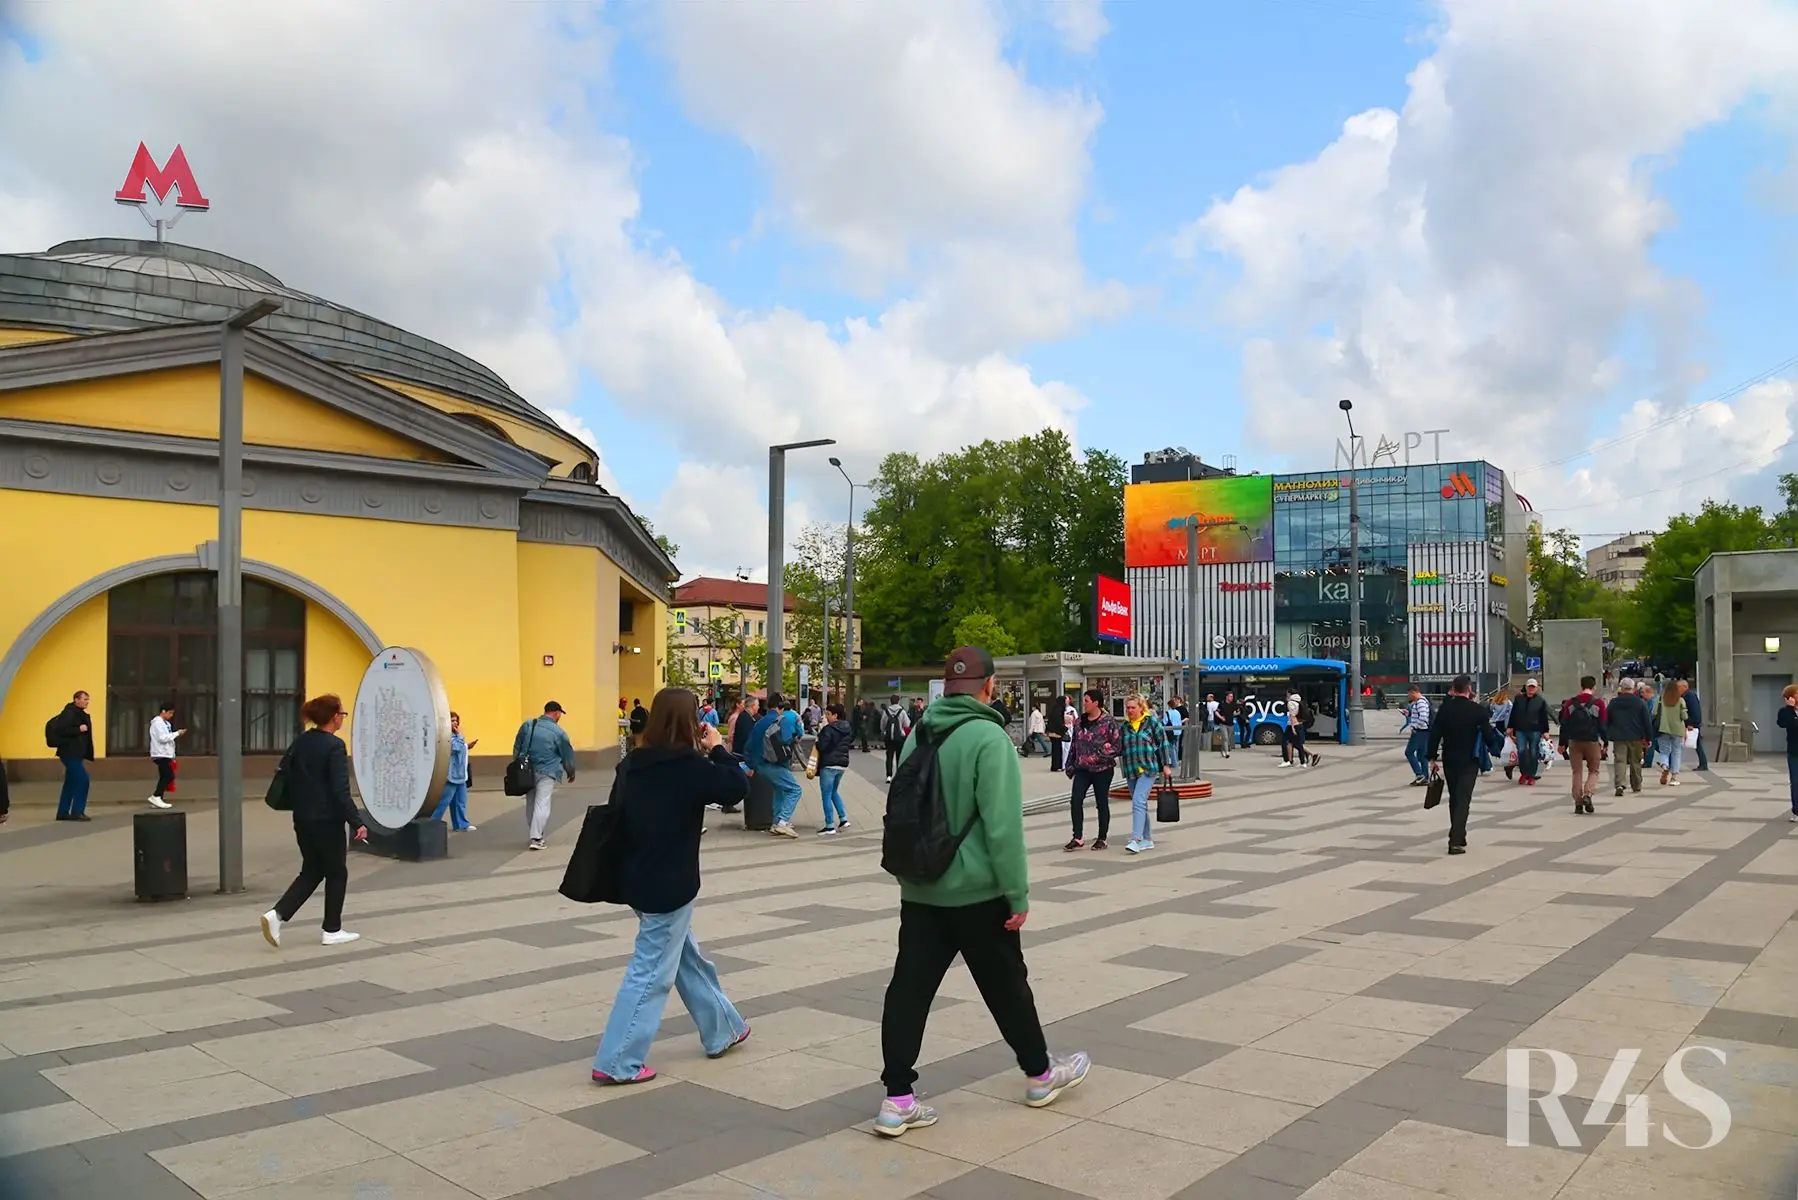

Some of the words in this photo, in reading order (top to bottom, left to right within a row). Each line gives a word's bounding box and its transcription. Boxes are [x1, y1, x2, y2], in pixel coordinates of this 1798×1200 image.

[1334, 429, 1450, 469] МАРТ
[1274, 479, 1338, 491] МАГНОЛИЯ
[1177, 547, 1217, 560] МРТ
[1319, 576, 1365, 600] kai
[1450, 600, 1476, 613] kari
[1299, 632, 1381, 649] Подрука
